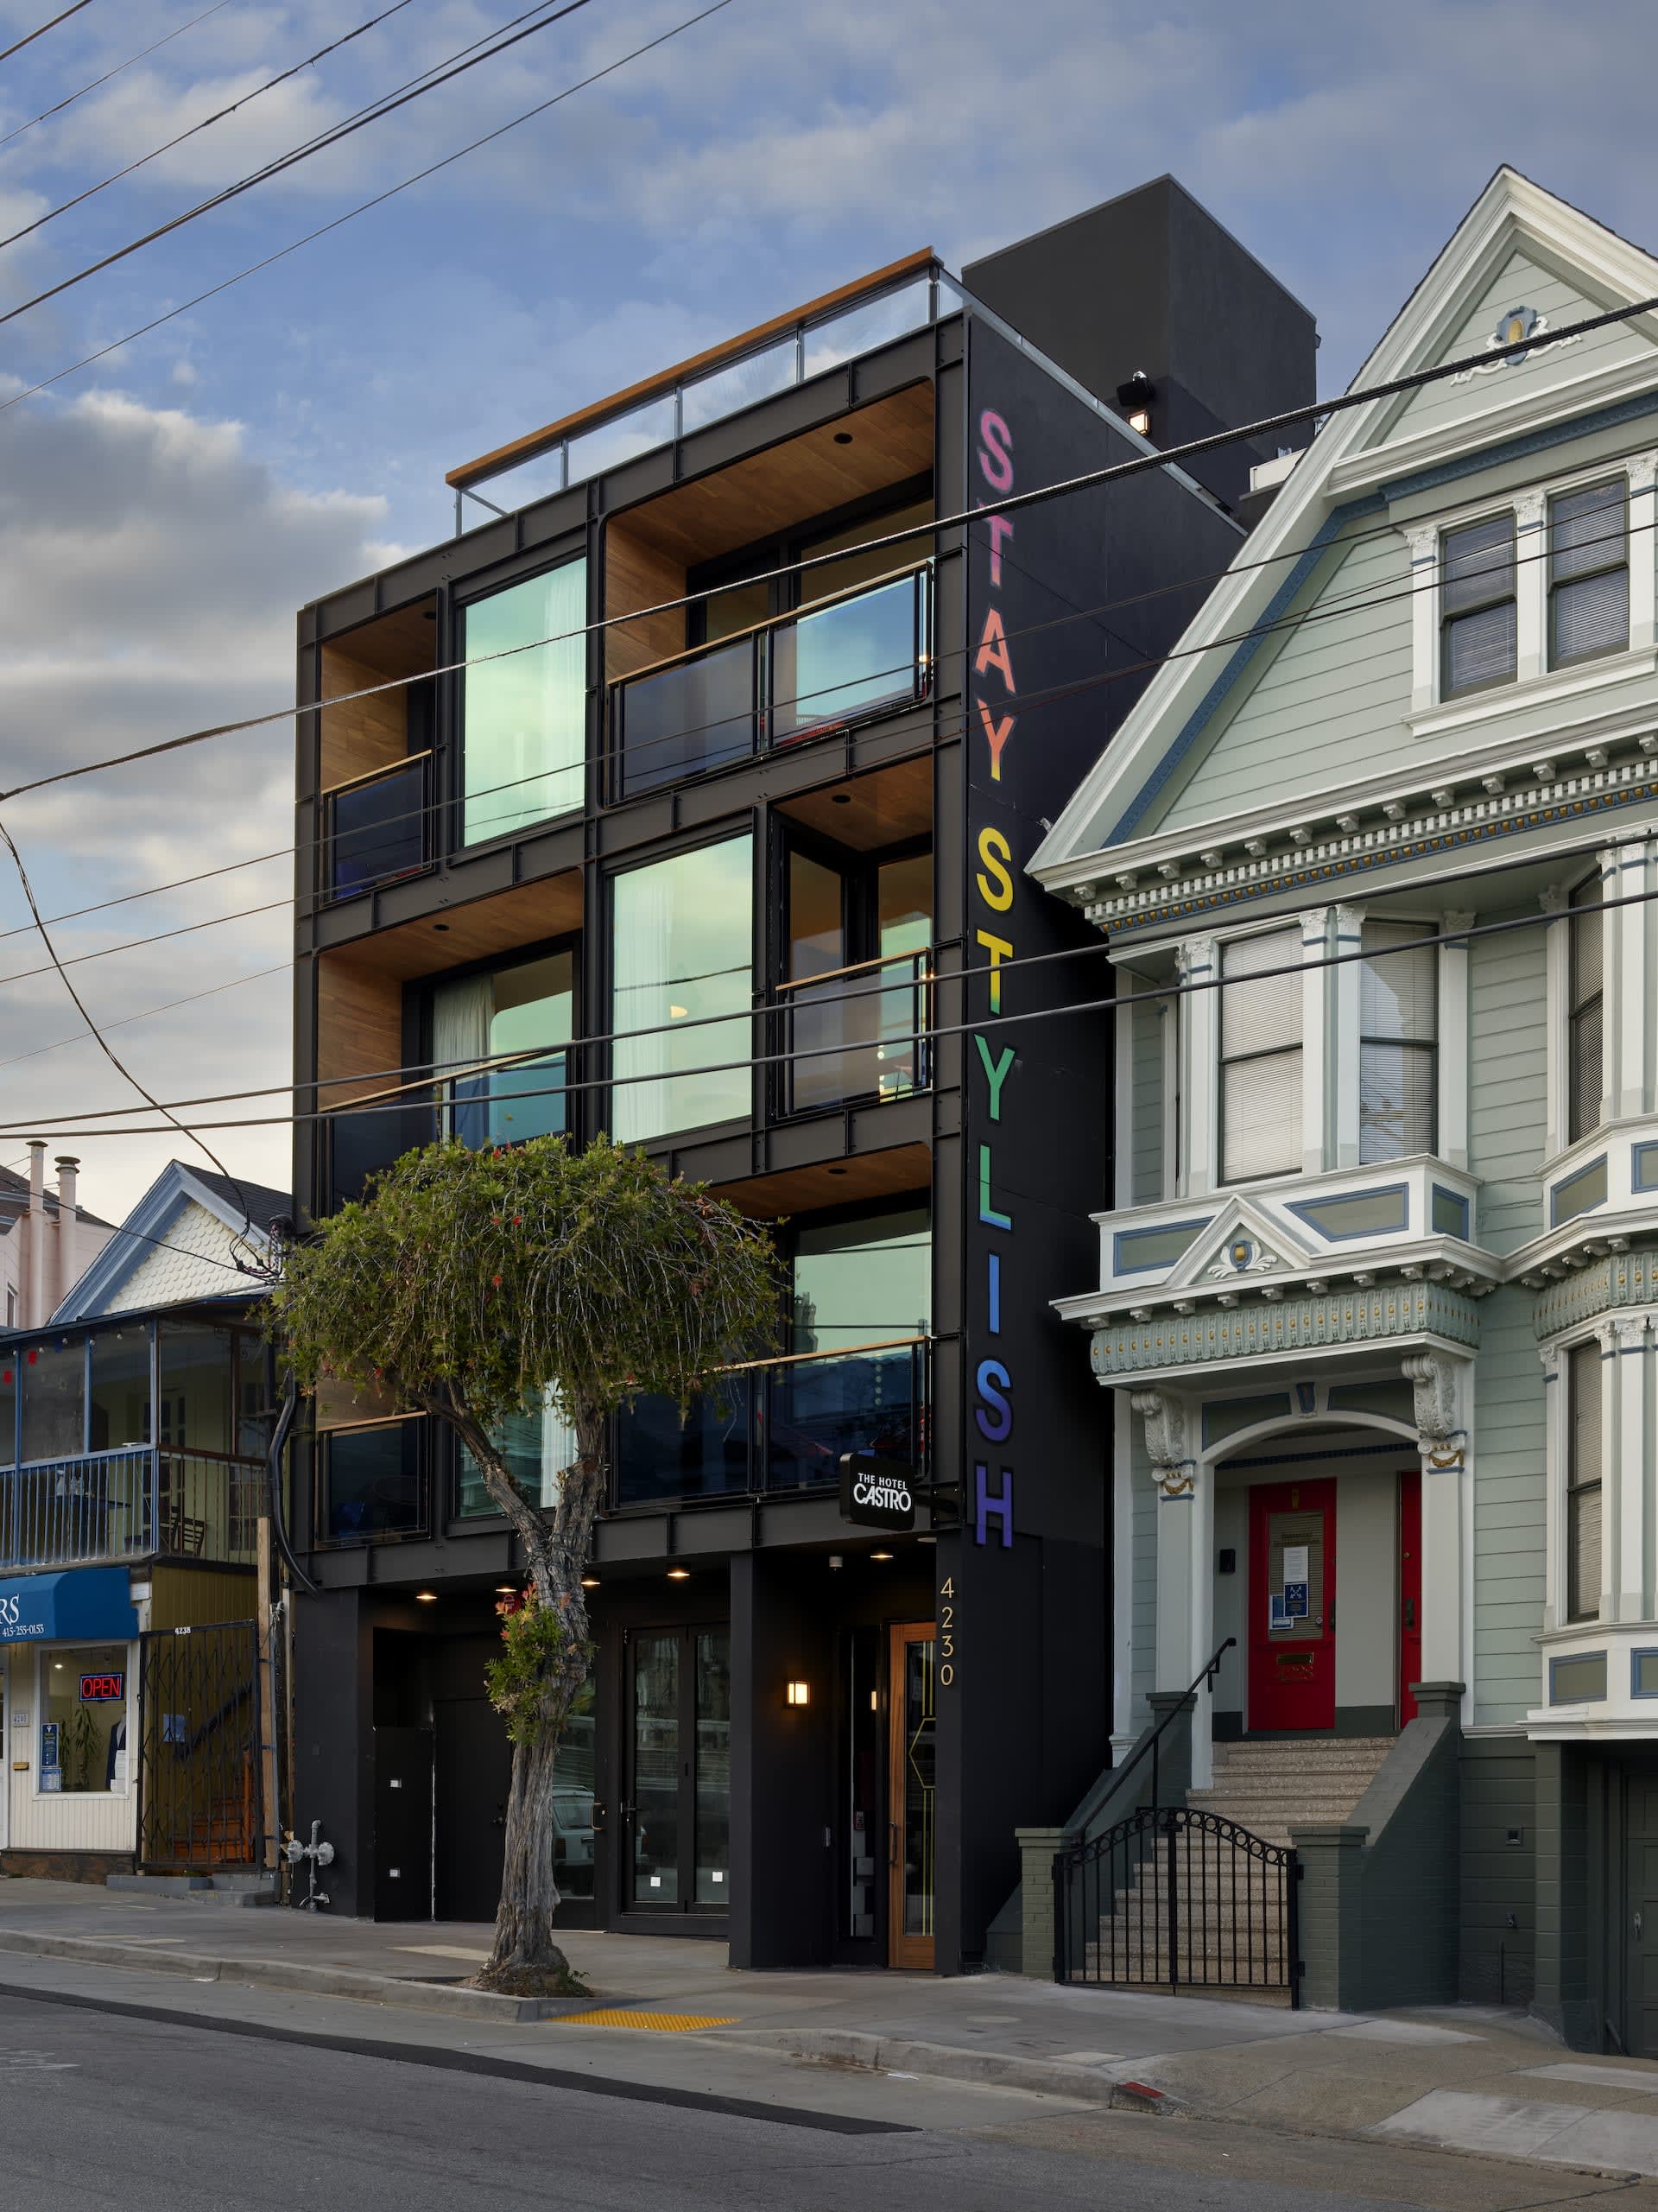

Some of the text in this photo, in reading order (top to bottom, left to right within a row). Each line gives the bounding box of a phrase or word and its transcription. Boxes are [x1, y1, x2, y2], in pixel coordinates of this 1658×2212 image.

[974, 409, 1016, 1548] STAY STYLISH
[857, 1473, 908, 1490] THE HOTEL
[853, 1483, 911, 1512] CASTRO
[3, 1624, 44, 1637] 415-255-0153
[940, 1577, 954, 1685] 4230
[82, 1677, 120, 1699] OPEN
